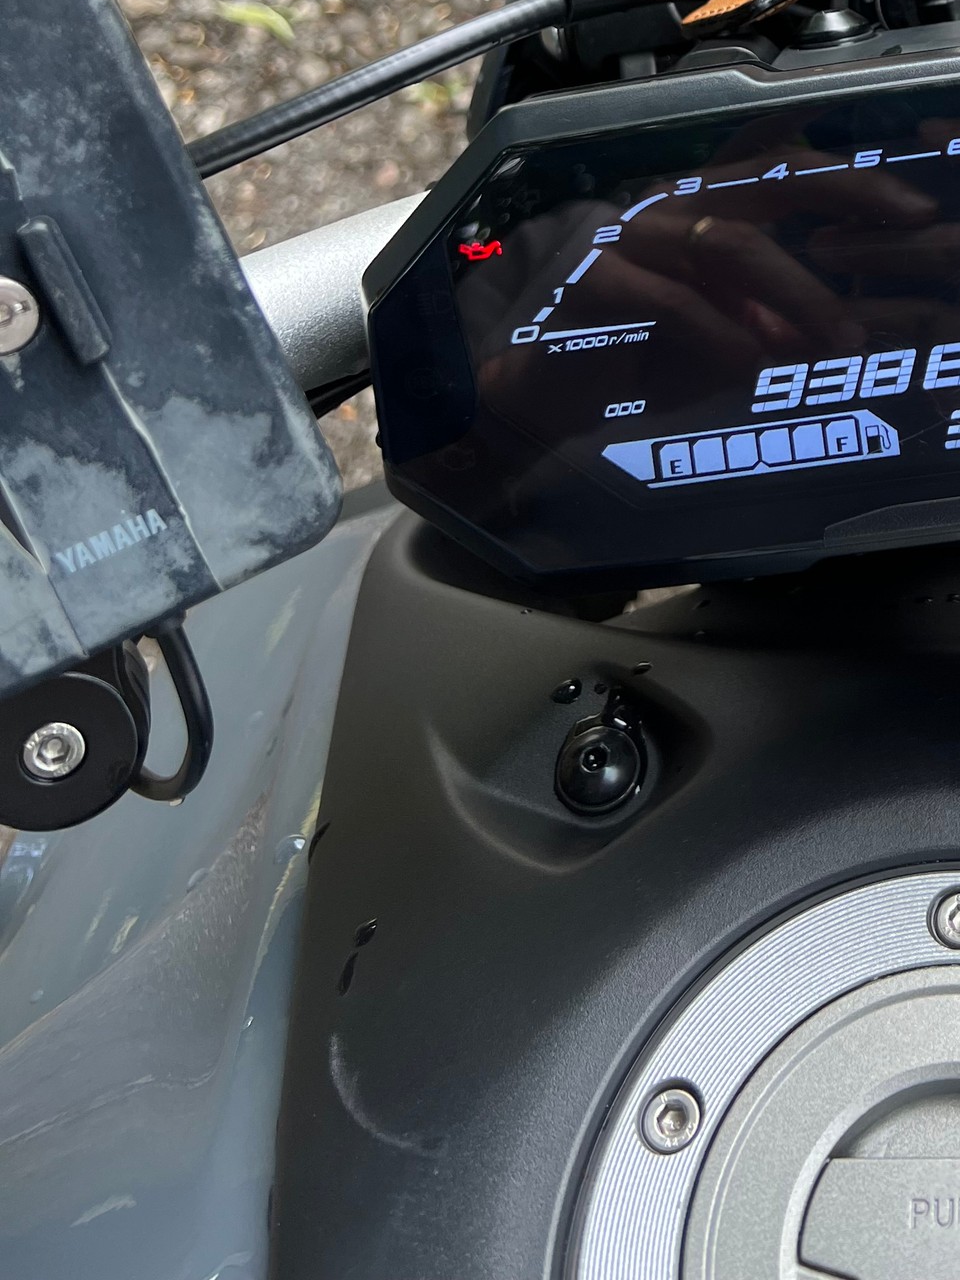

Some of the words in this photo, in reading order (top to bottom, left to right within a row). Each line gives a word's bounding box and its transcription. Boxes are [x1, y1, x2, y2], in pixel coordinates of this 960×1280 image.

[853, 149, 883, 169] 5
[762, 162, 790, 181] 4
[673, 176, 703, 196] 3
[593, 224, 623, 244] 2
[552, 286, 564, 305] 1
[511, 324, 541, 345] 0
[604, 399, 646, 419] ODO
[836, 436, 849, 453] F
[671, 458, 684, 475] E
[53, 507, 169, 574] YAMAHA
